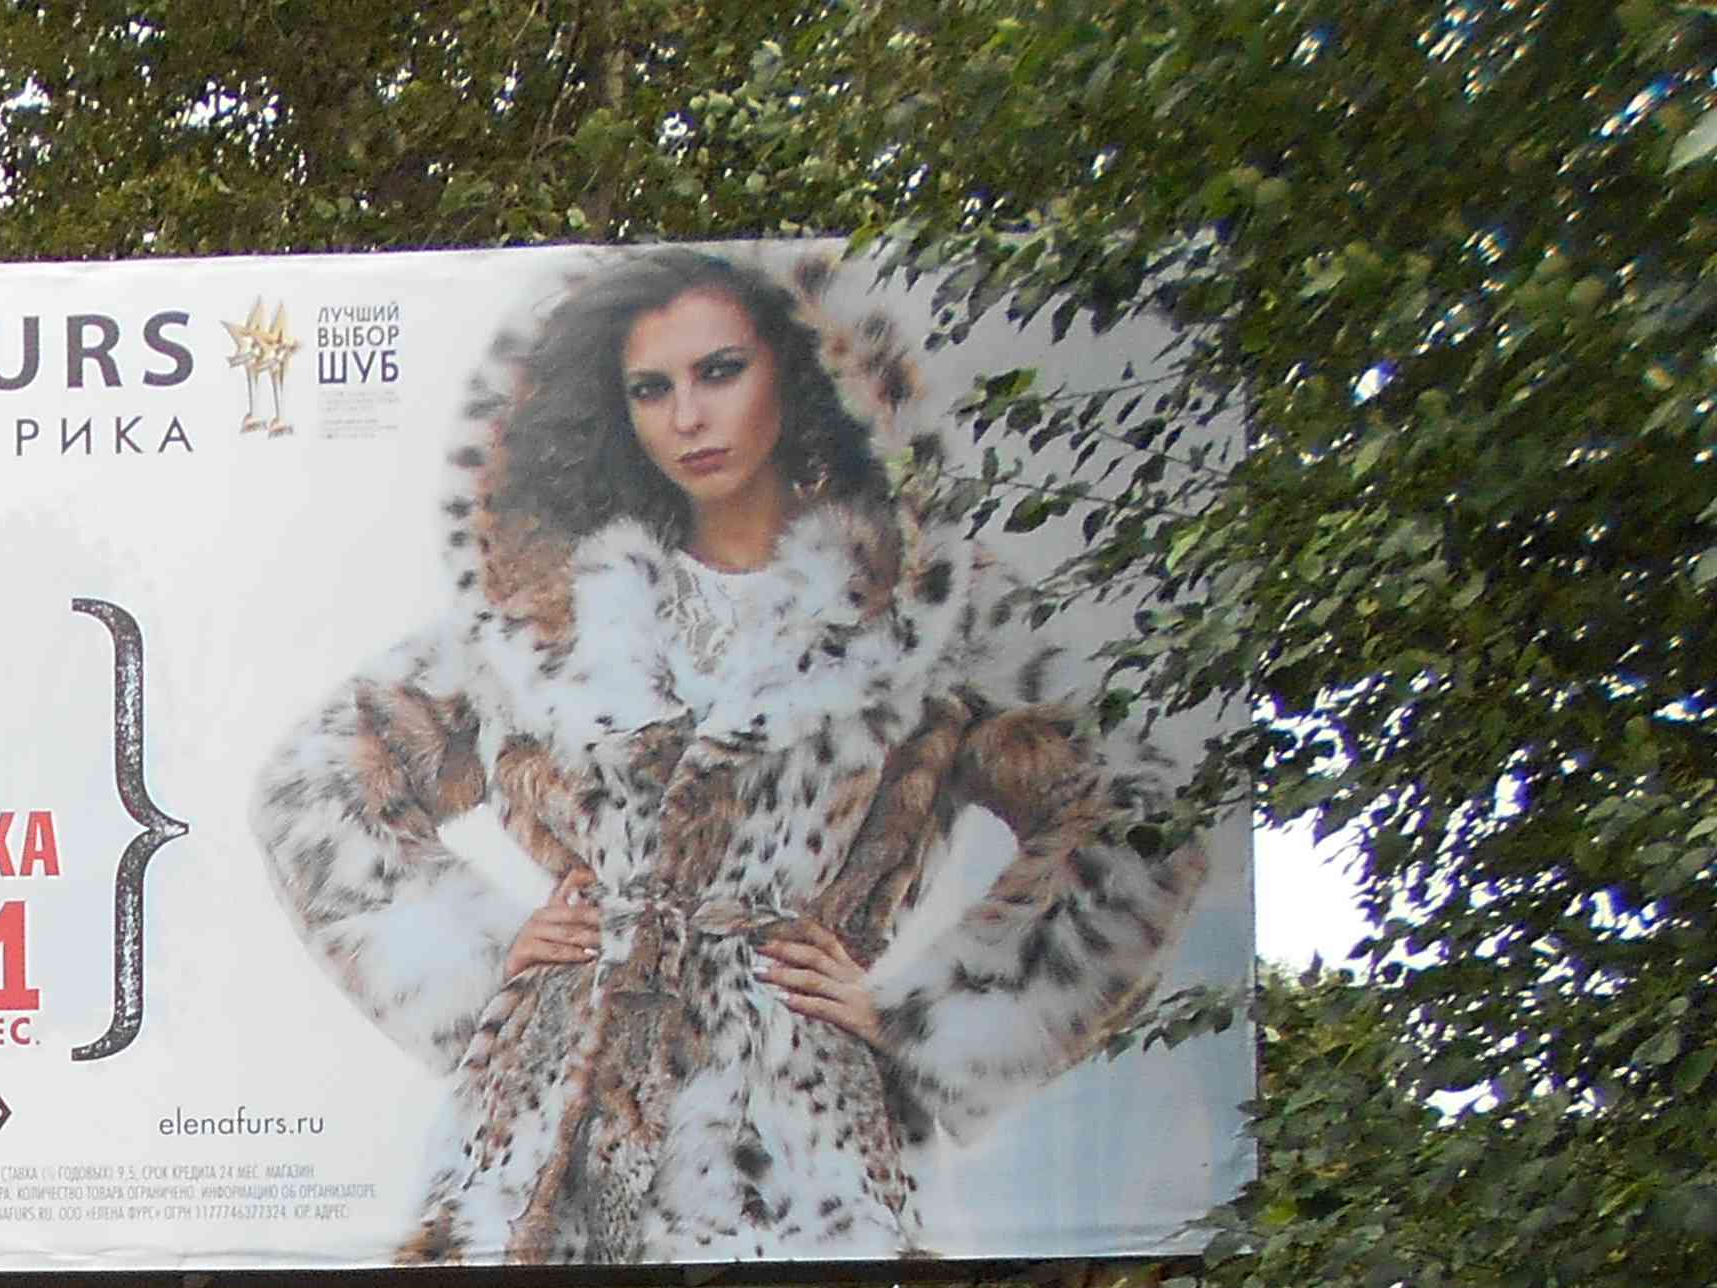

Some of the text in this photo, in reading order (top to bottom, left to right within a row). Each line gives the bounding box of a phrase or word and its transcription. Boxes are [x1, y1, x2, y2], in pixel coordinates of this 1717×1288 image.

[317, 300, 400, 323] ЛУЧШИЙ
[317, 325, 400, 348] ВЫБОР
[318, 350, 399, 384] ШУБ
[158, 1104, 326, 1138] elenafurs.ru
[1, 1167, 38, 1181] СТАВКА
[141, 1166, 167, 1180] СРОК
[172, 1165, 216, 1182] КРЕДИТА
[265, 1165, 314, 1179] МАГАЗИН
[59, 1207, 82, 1221] ООО
